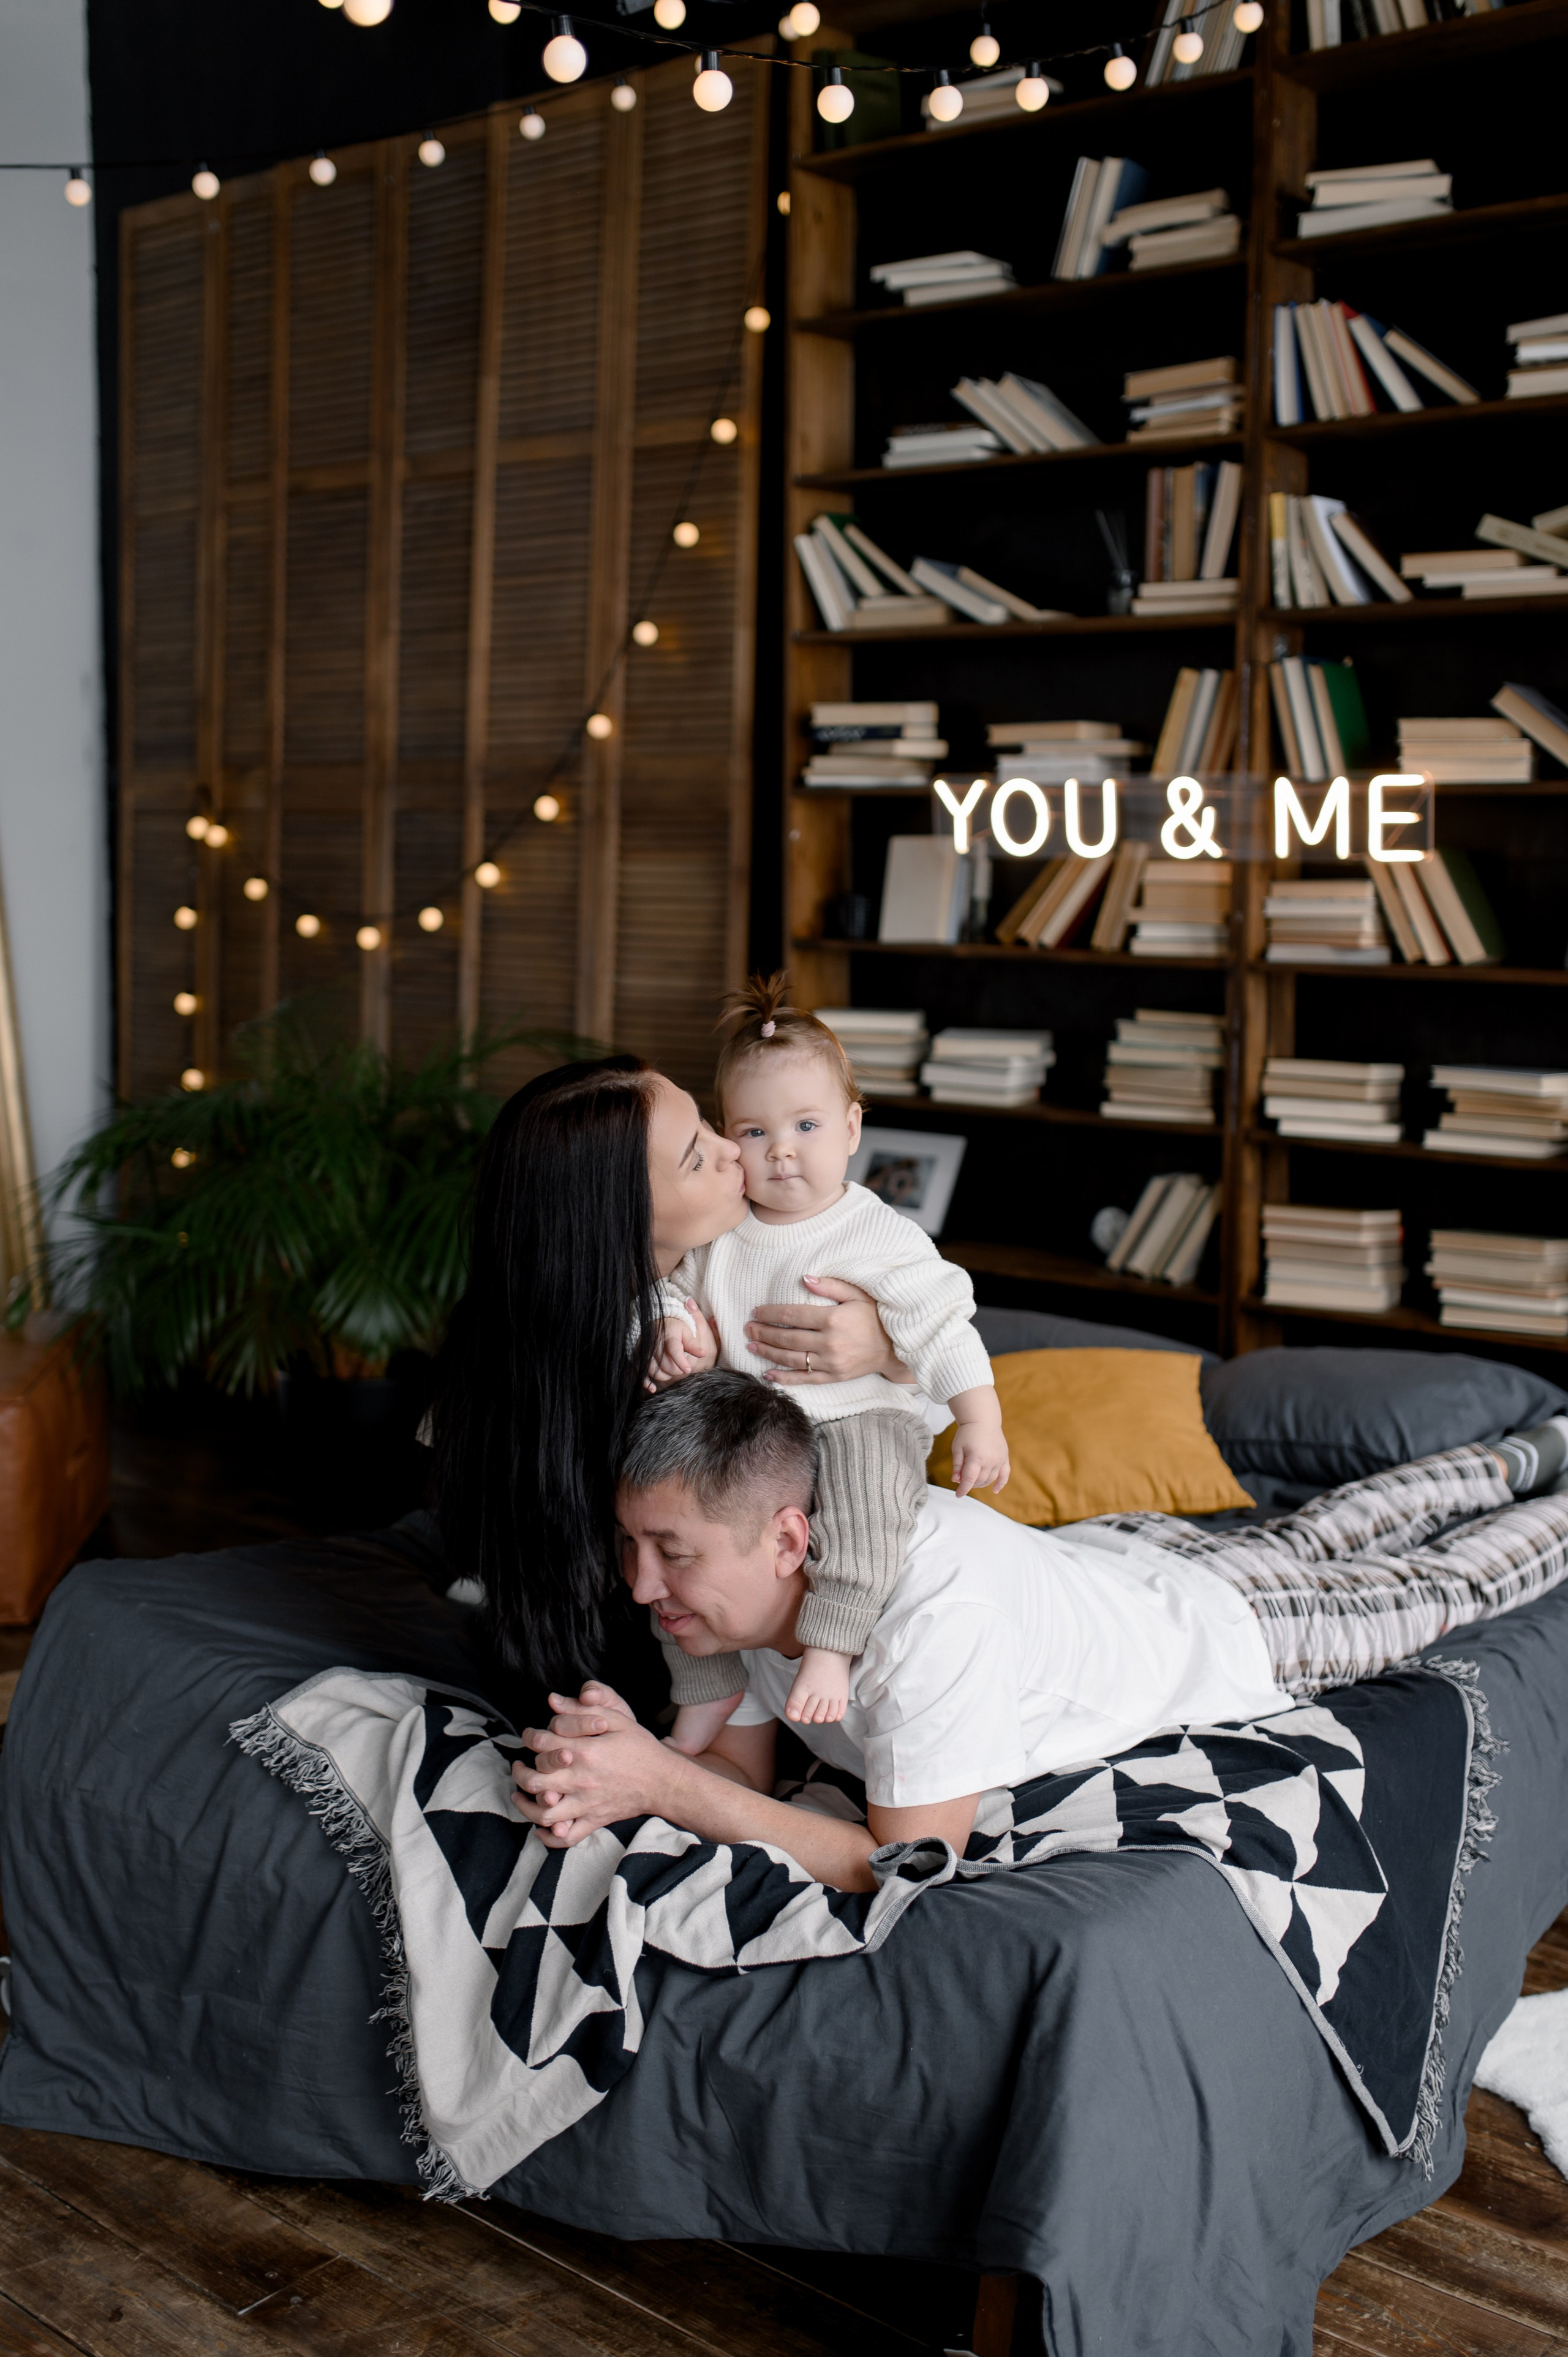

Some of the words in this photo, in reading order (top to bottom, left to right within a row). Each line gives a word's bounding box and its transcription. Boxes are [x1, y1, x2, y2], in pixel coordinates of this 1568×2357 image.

[933, 777, 1118, 859] YOU
[1160, 775, 1223, 860] &
[1274, 774, 1427, 862] ME
